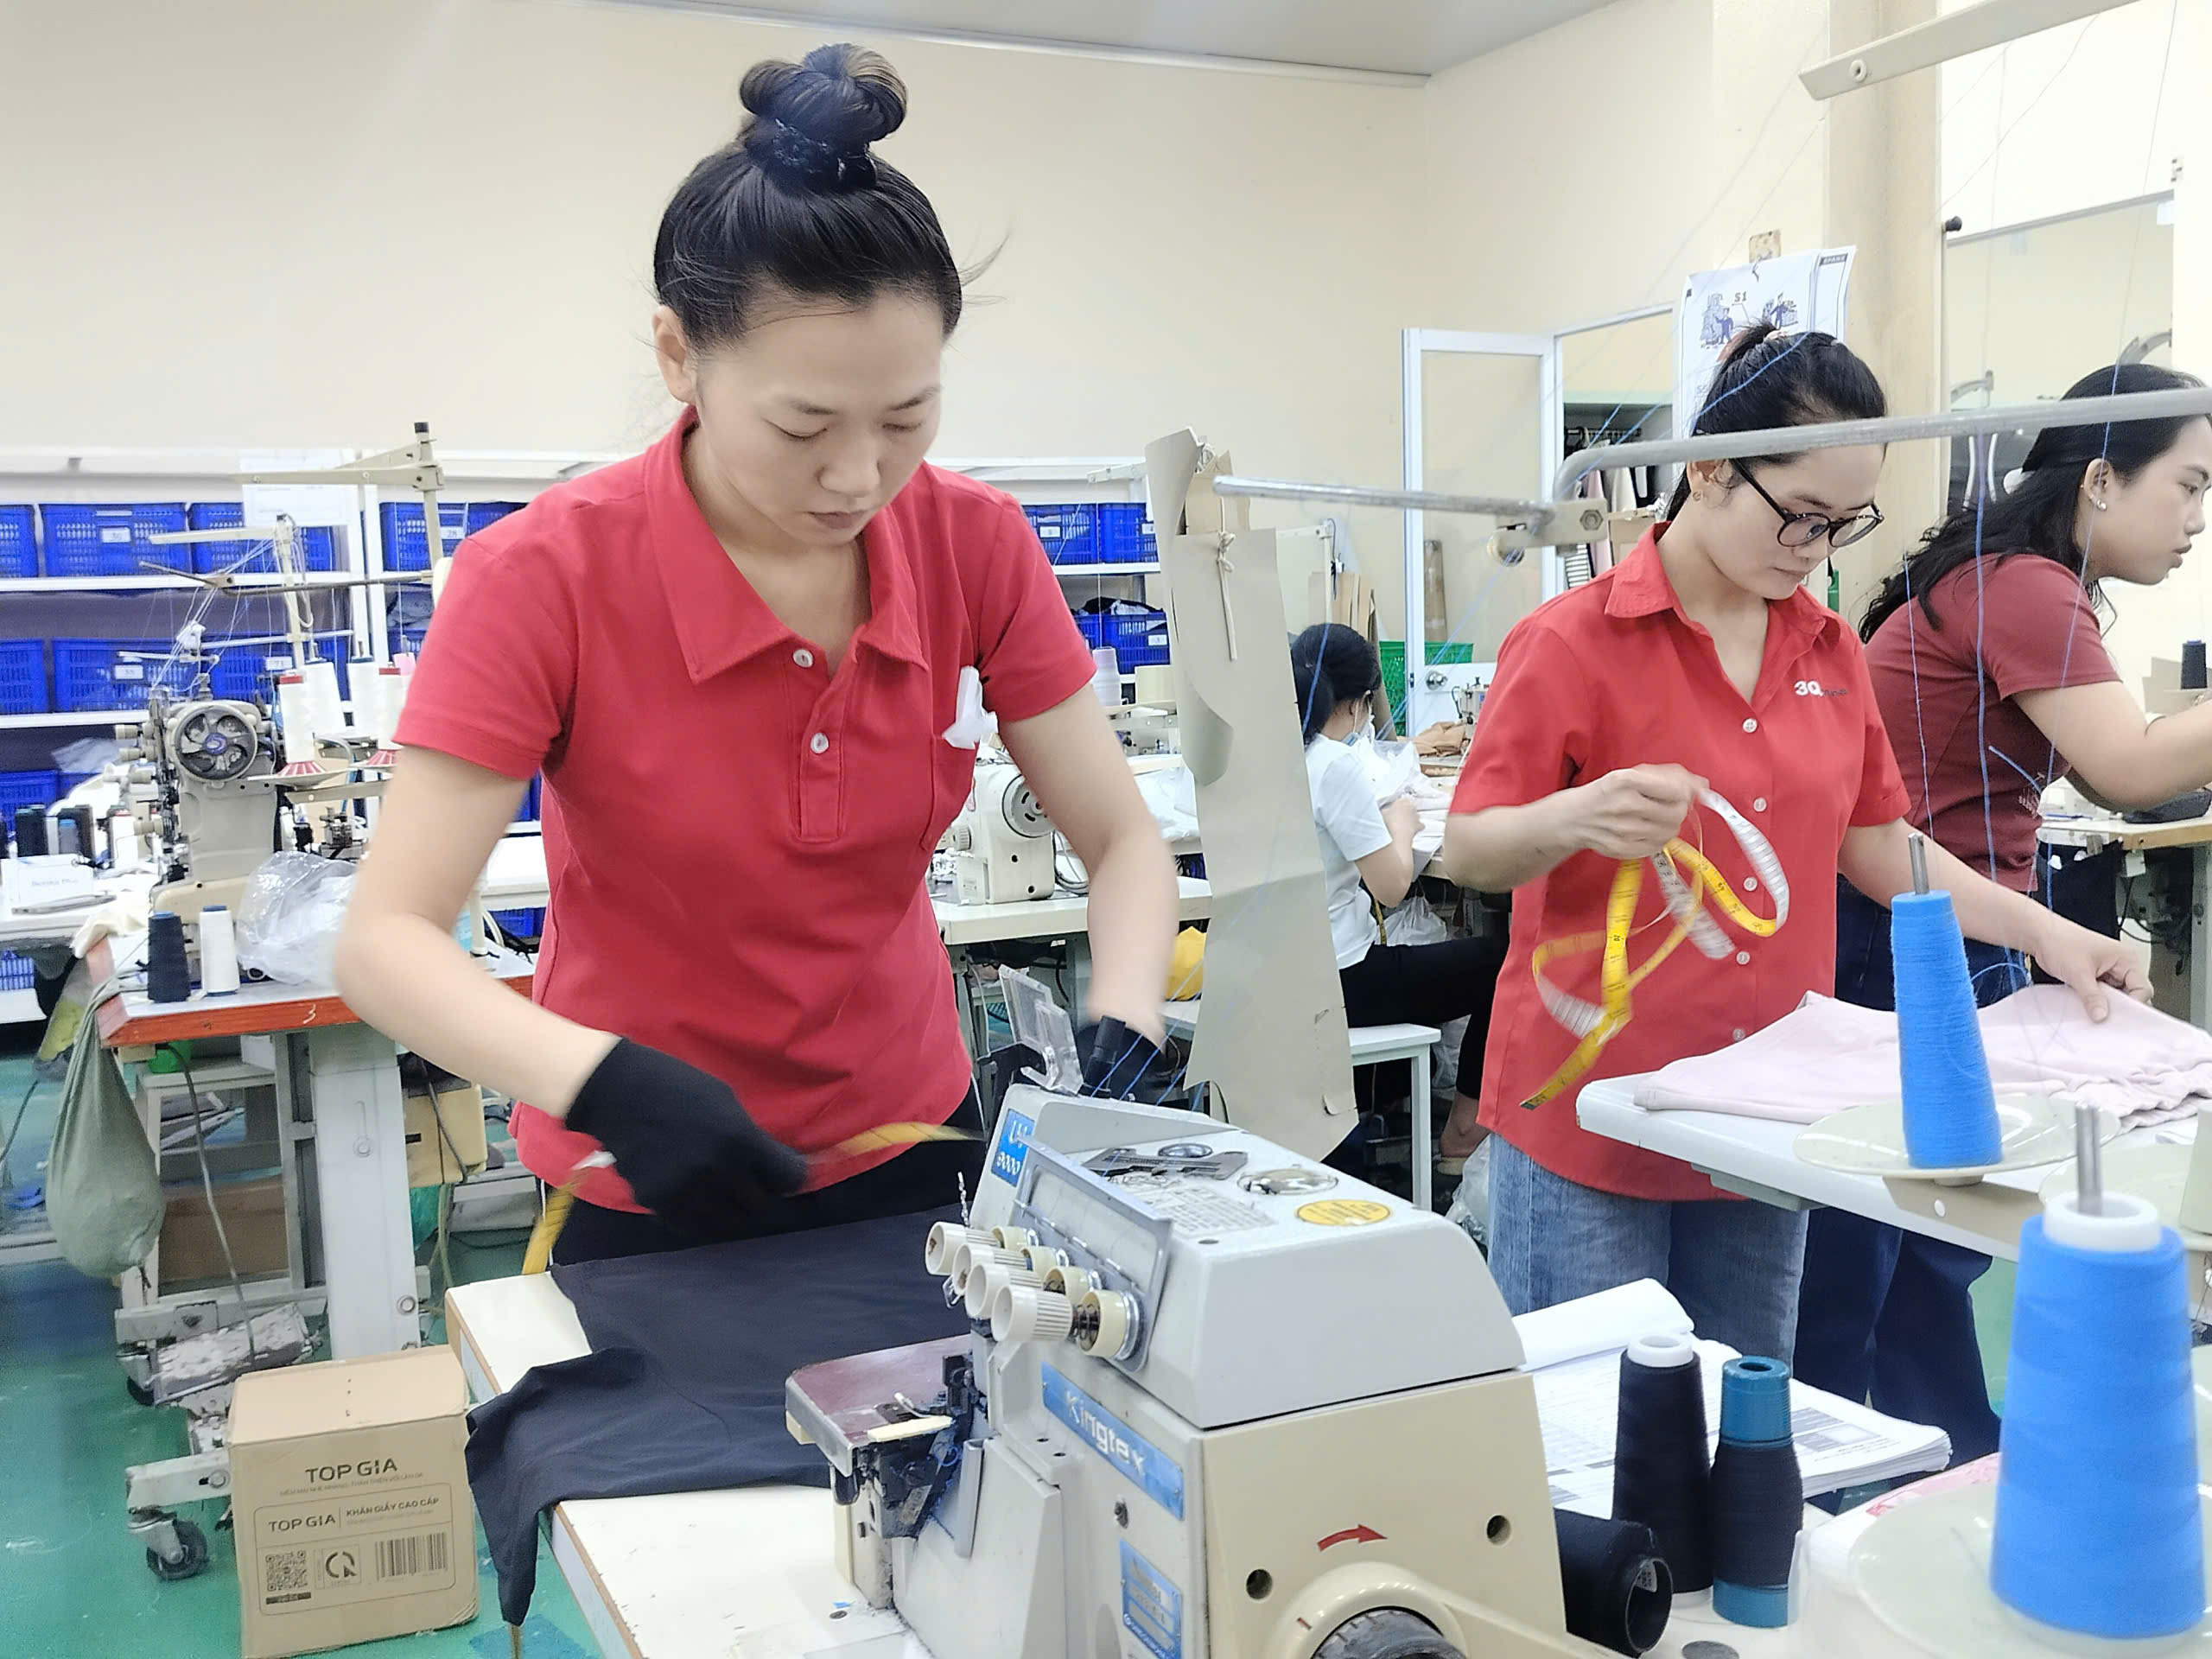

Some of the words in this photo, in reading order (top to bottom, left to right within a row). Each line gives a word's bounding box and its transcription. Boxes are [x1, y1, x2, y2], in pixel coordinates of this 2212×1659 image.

[1065, 1389, 1146, 1477] Kingtex
[305, 1463, 353, 1484] TOP
[357, 1458, 398, 1477] GIA
[268, 1518, 302, 1532] TOP
[306, 1514, 336, 1528] GIA
